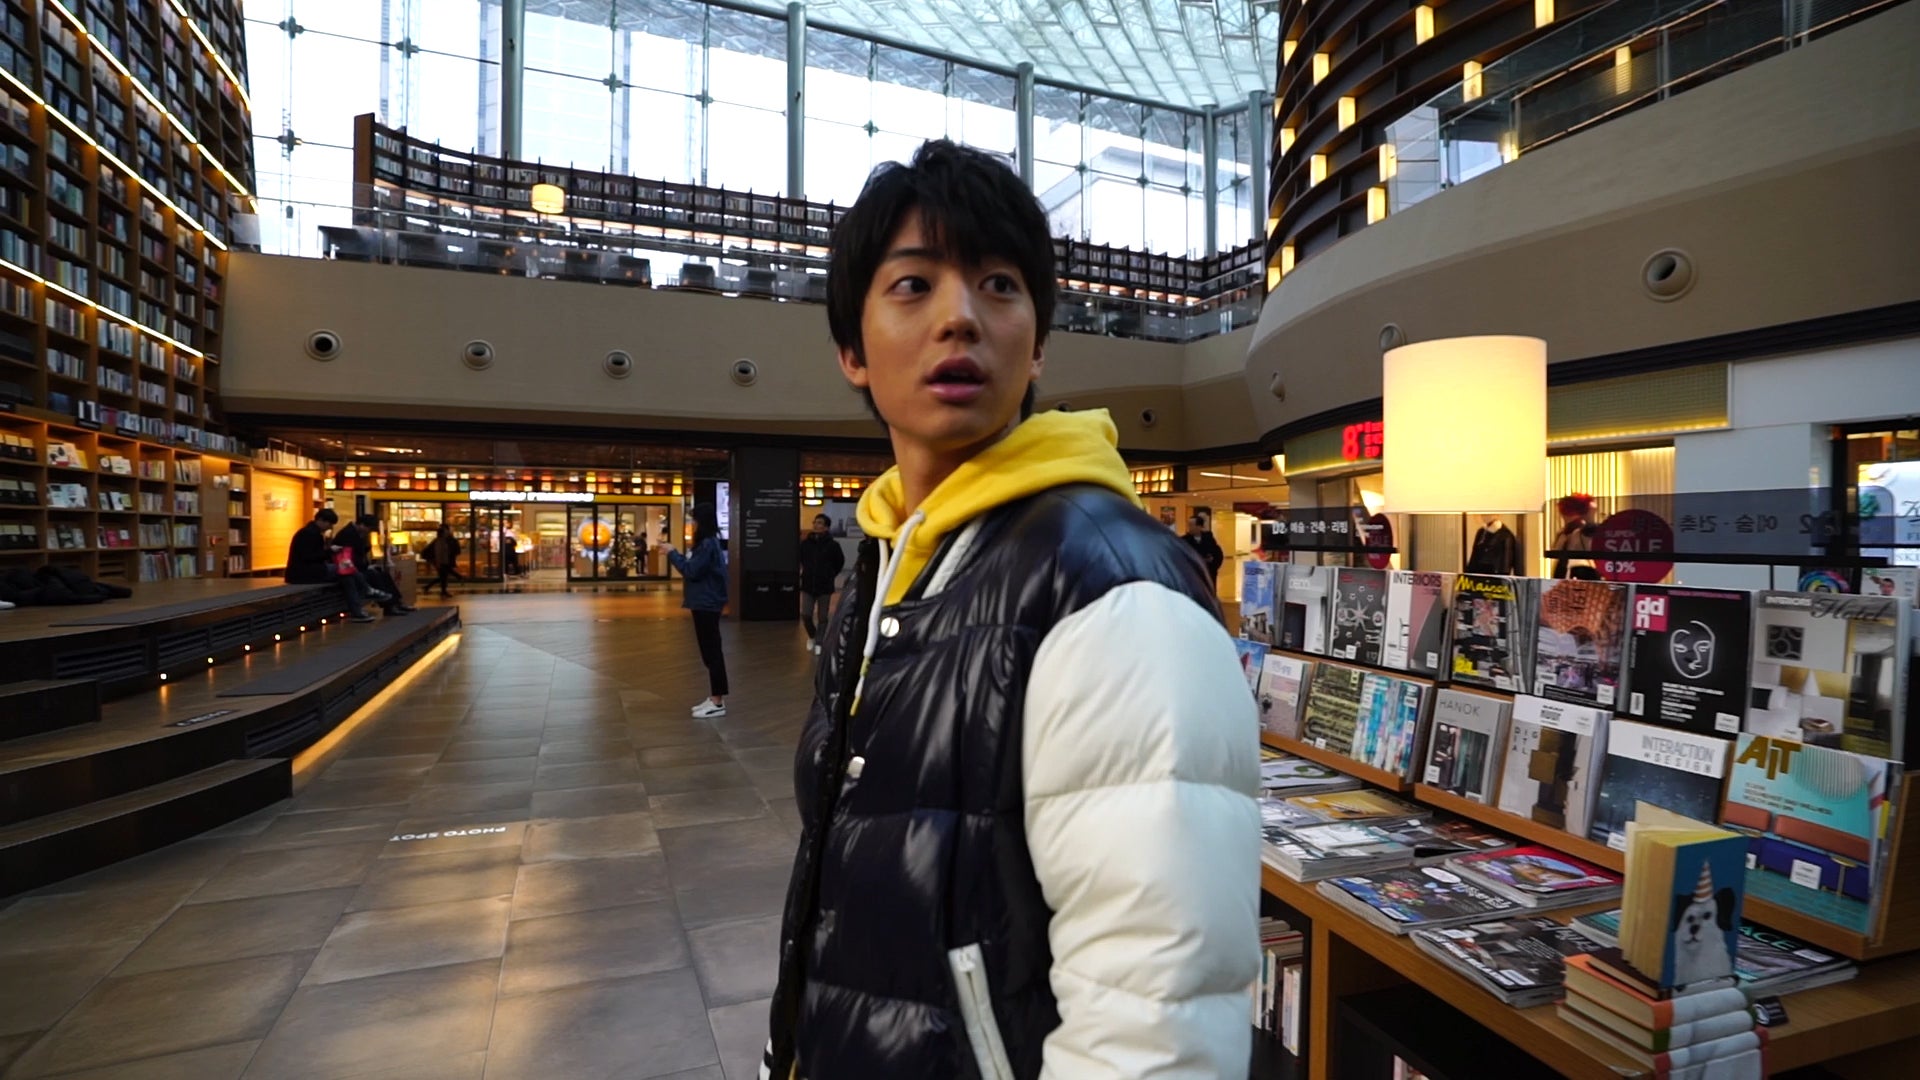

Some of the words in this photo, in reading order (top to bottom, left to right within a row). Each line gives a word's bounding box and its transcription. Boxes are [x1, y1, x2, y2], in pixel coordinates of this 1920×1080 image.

[1604, 538, 1663, 553] SALE
[1392, 572, 1442, 587] INTERIORS
[1455, 575, 1512, 595] Maison
[1439, 700, 1481, 717] HANOK
[1642, 735, 1716, 763] INTERACTION
[388, 831, 440, 842] SPOT
[443, 826, 507, 837] PHOTO
